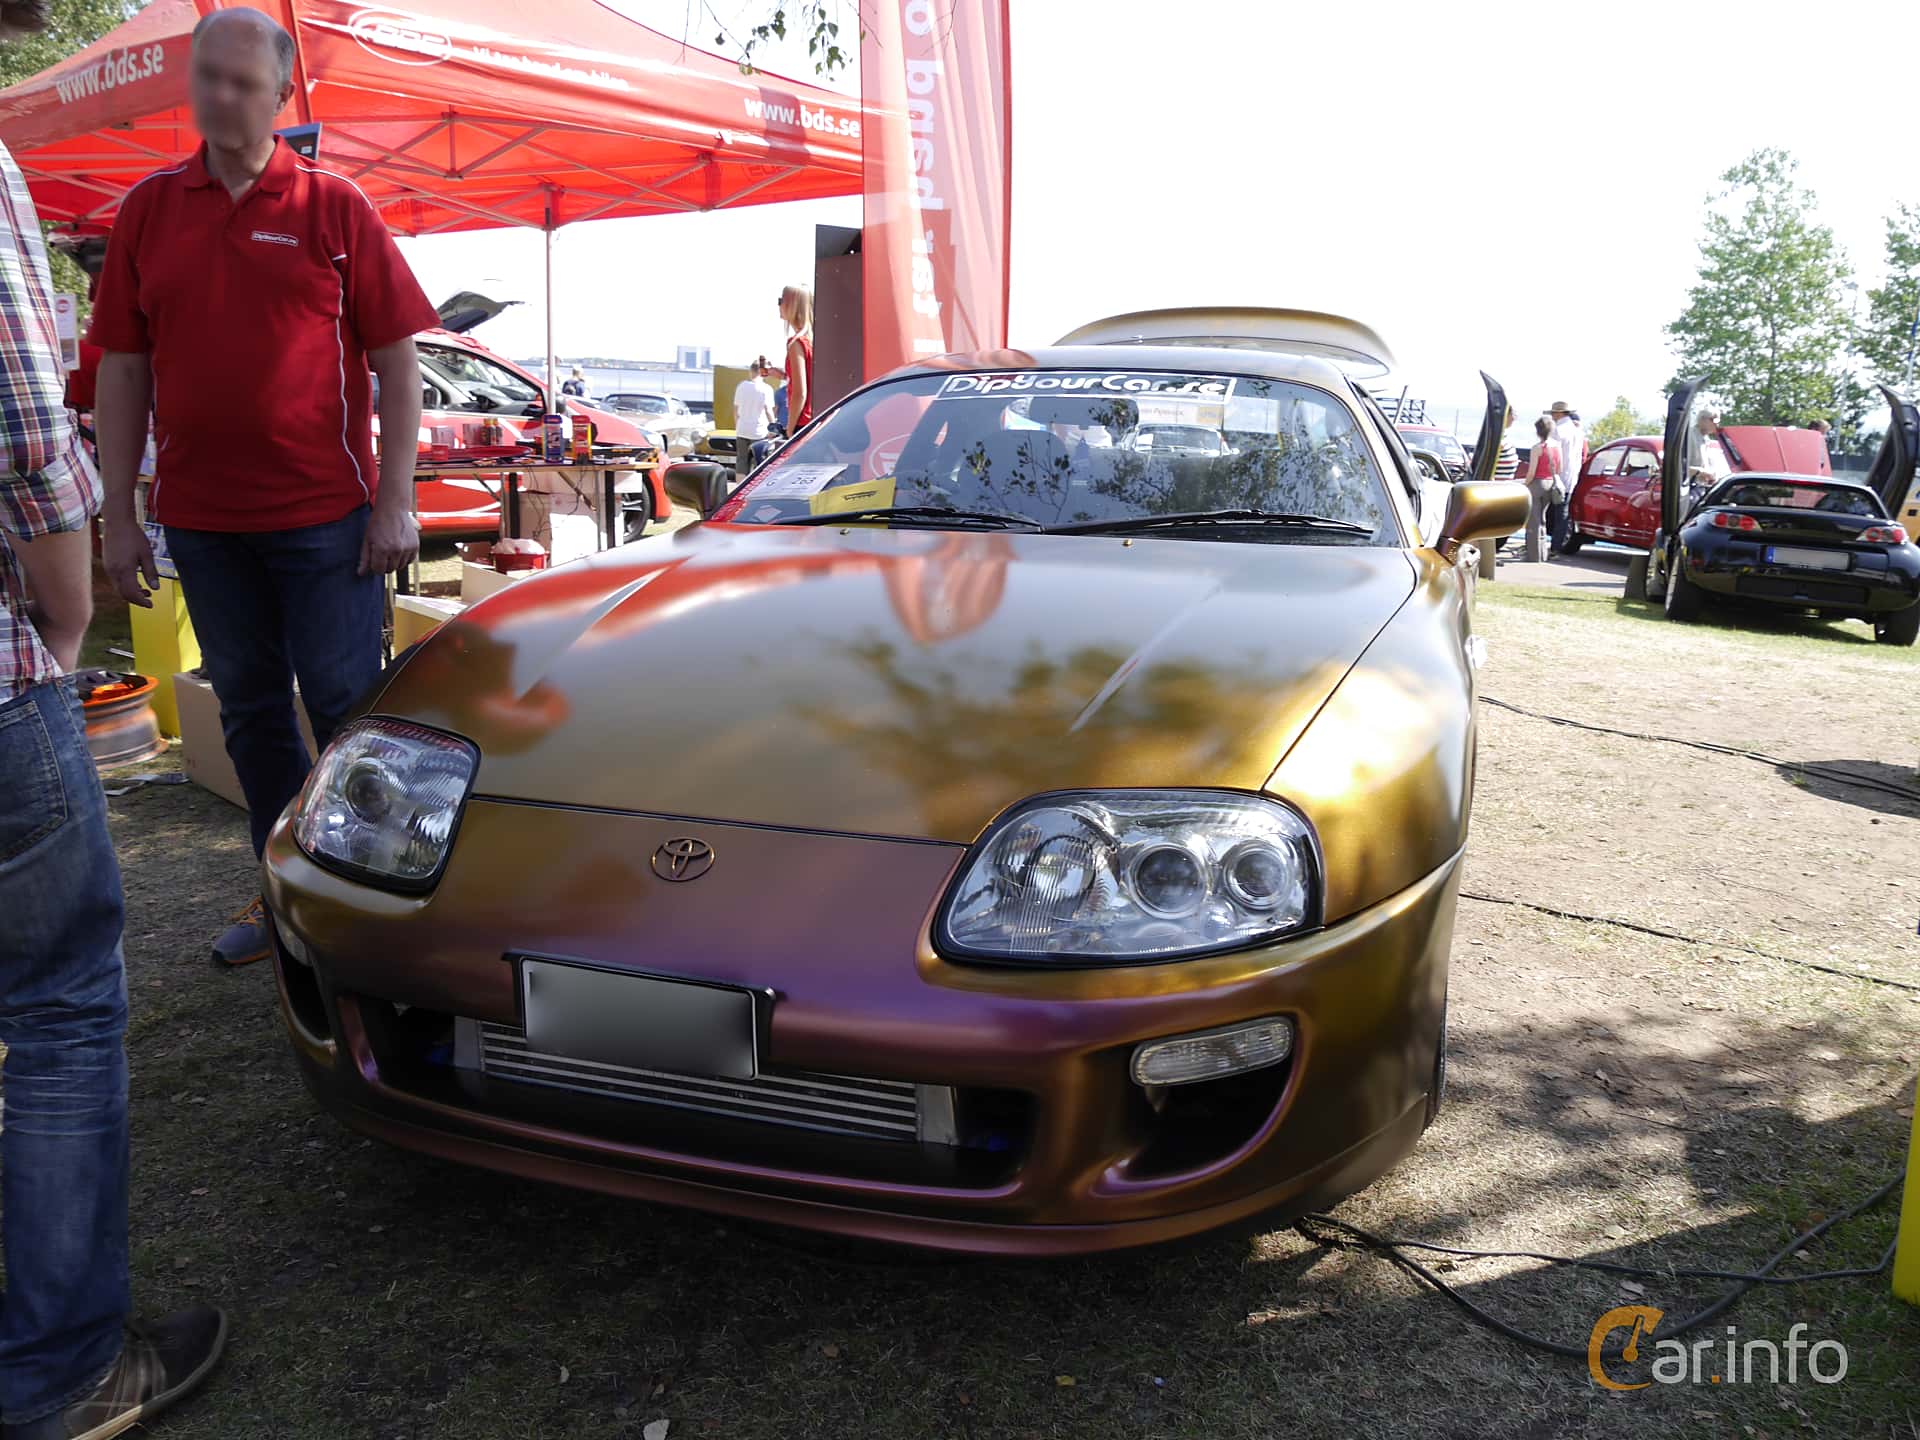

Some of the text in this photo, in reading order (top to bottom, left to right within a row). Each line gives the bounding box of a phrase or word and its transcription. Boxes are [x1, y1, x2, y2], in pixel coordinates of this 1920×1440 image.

[56, 44, 164, 104] www.bds.se
[743, 98, 860, 138] www.bds.se
[946, 375, 1226, 394] DipYourCar.se
